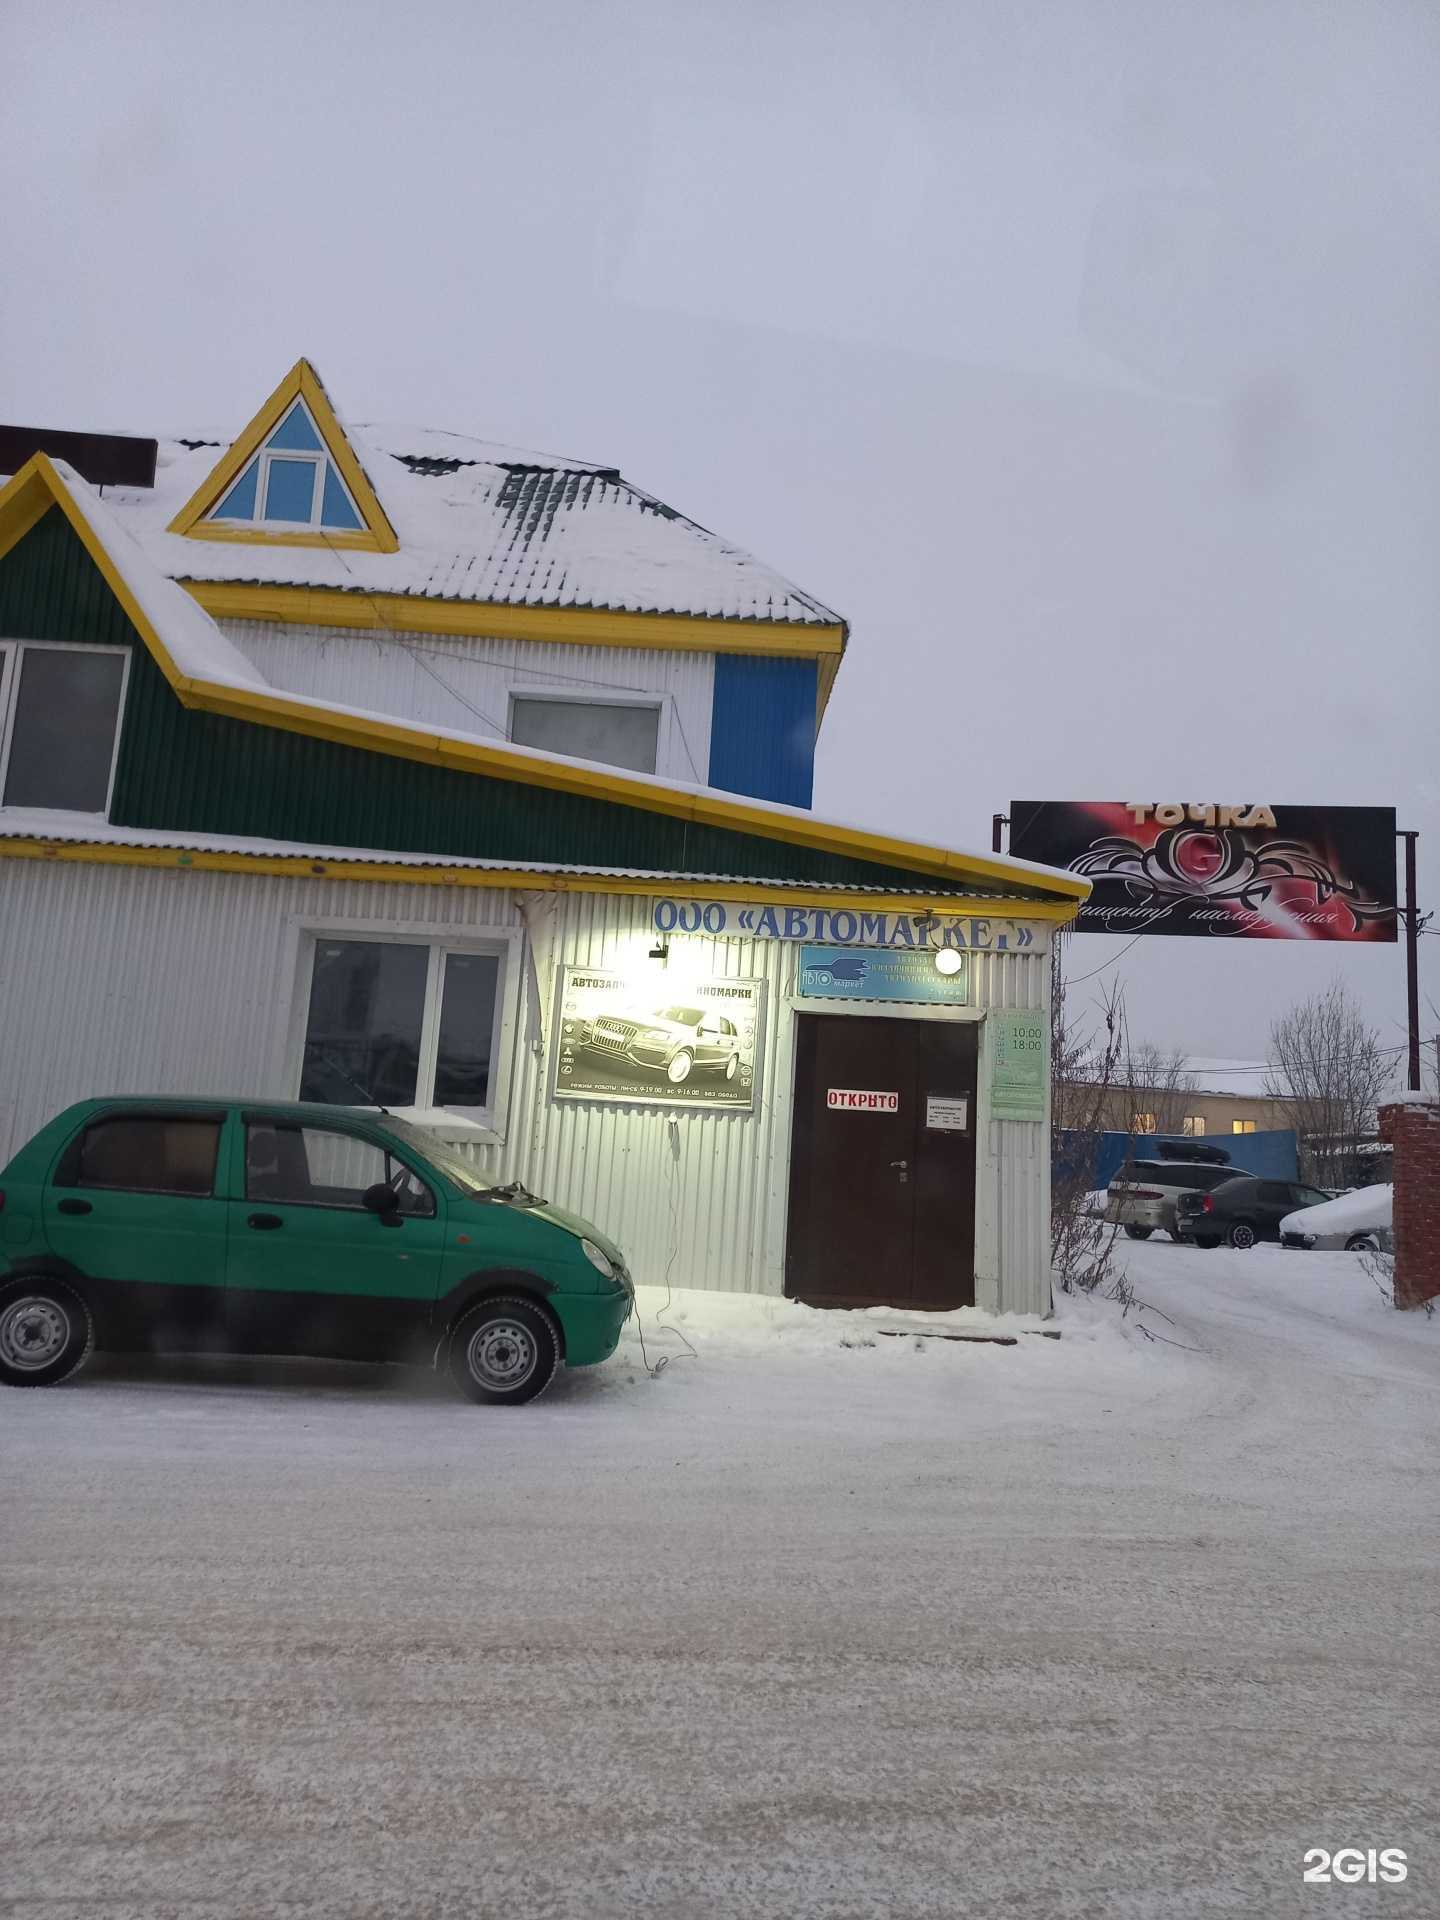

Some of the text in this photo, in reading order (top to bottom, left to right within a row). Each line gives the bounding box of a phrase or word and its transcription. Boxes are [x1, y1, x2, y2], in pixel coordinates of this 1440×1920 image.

[654, 900, 727, 934] ООО
[1012, 1027, 1042, 1039] 10:00
[1012, 1039, 1042, 1051] 18:00
[828, 1092, 897, 1109] ОТКРЫТО
